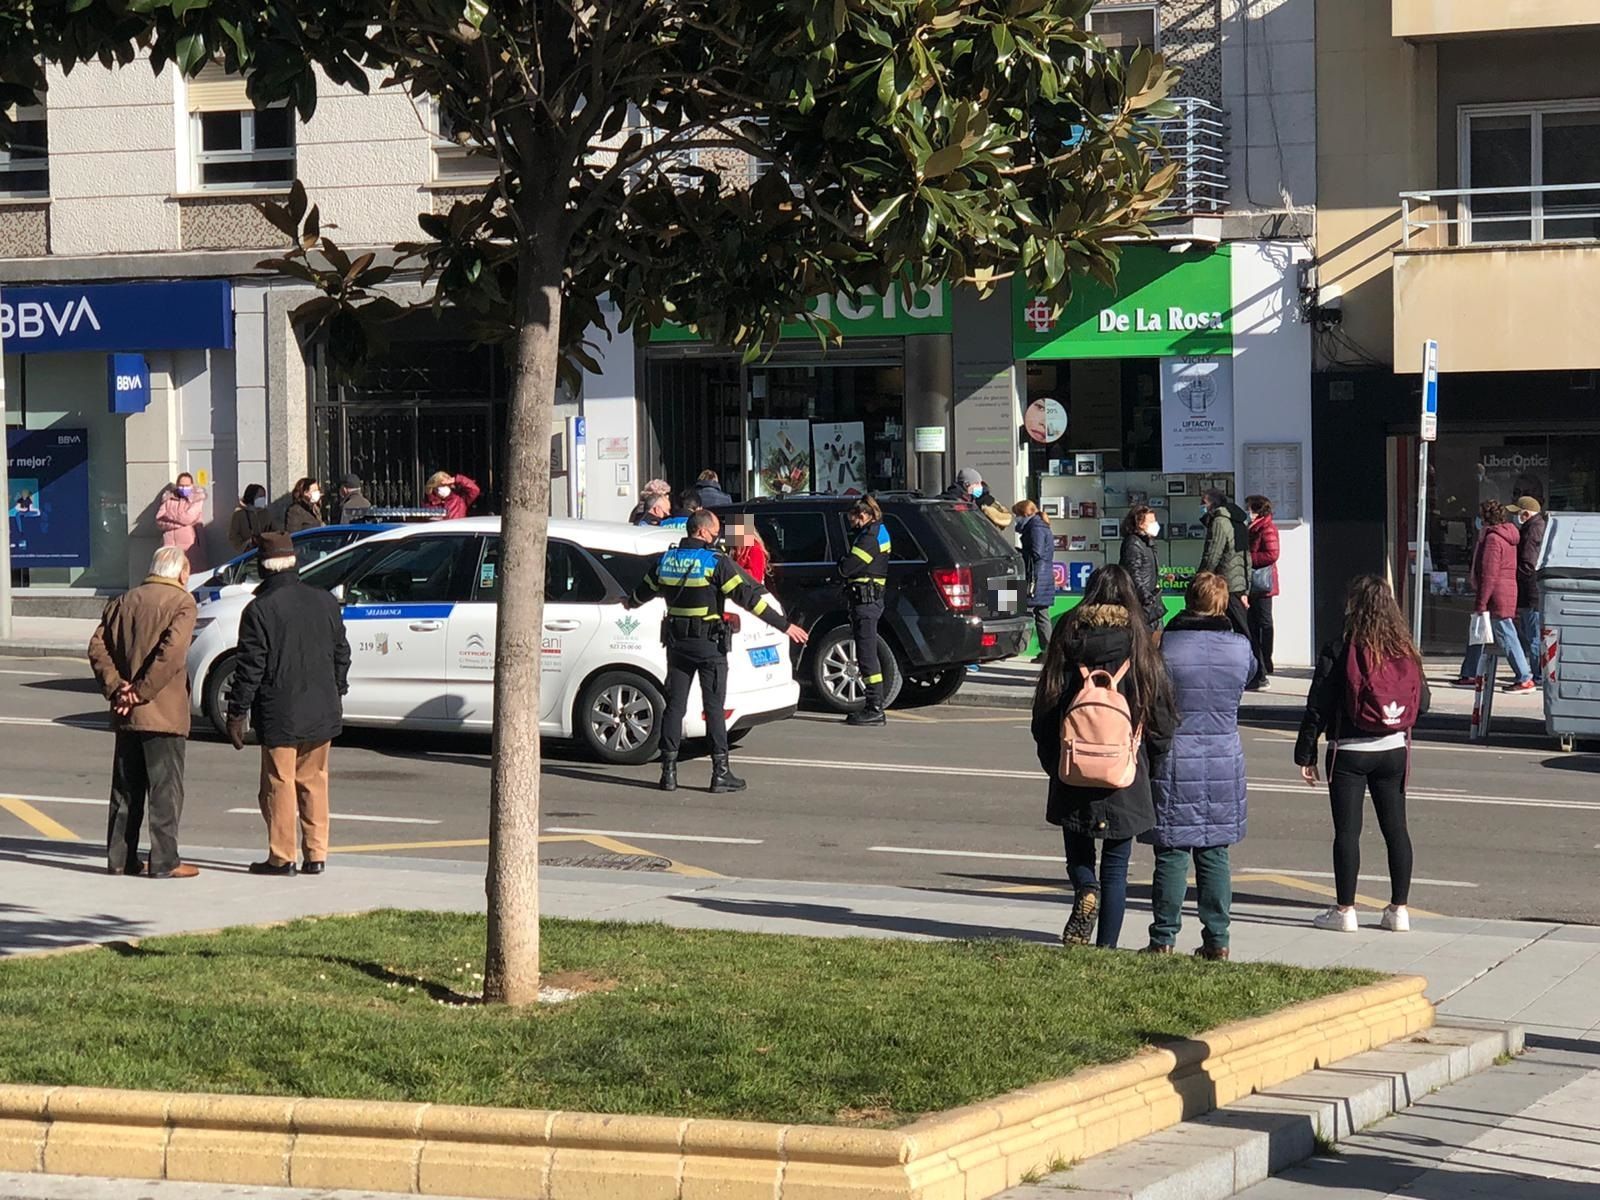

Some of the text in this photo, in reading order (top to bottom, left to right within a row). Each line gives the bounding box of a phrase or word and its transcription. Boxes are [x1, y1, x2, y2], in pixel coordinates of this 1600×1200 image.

[0, 296, 101, 338] BBVA
[1099, 306, 1224, 332] De La Rosa
[116, 374, 142, 391] BBVA
[1182, 420, 1215, 428] LIFTACTIV
[58, 436, 81, 444] BBVA
[17, 456, 52, 469] mejor?
[359, 642, 374, 651] 219
